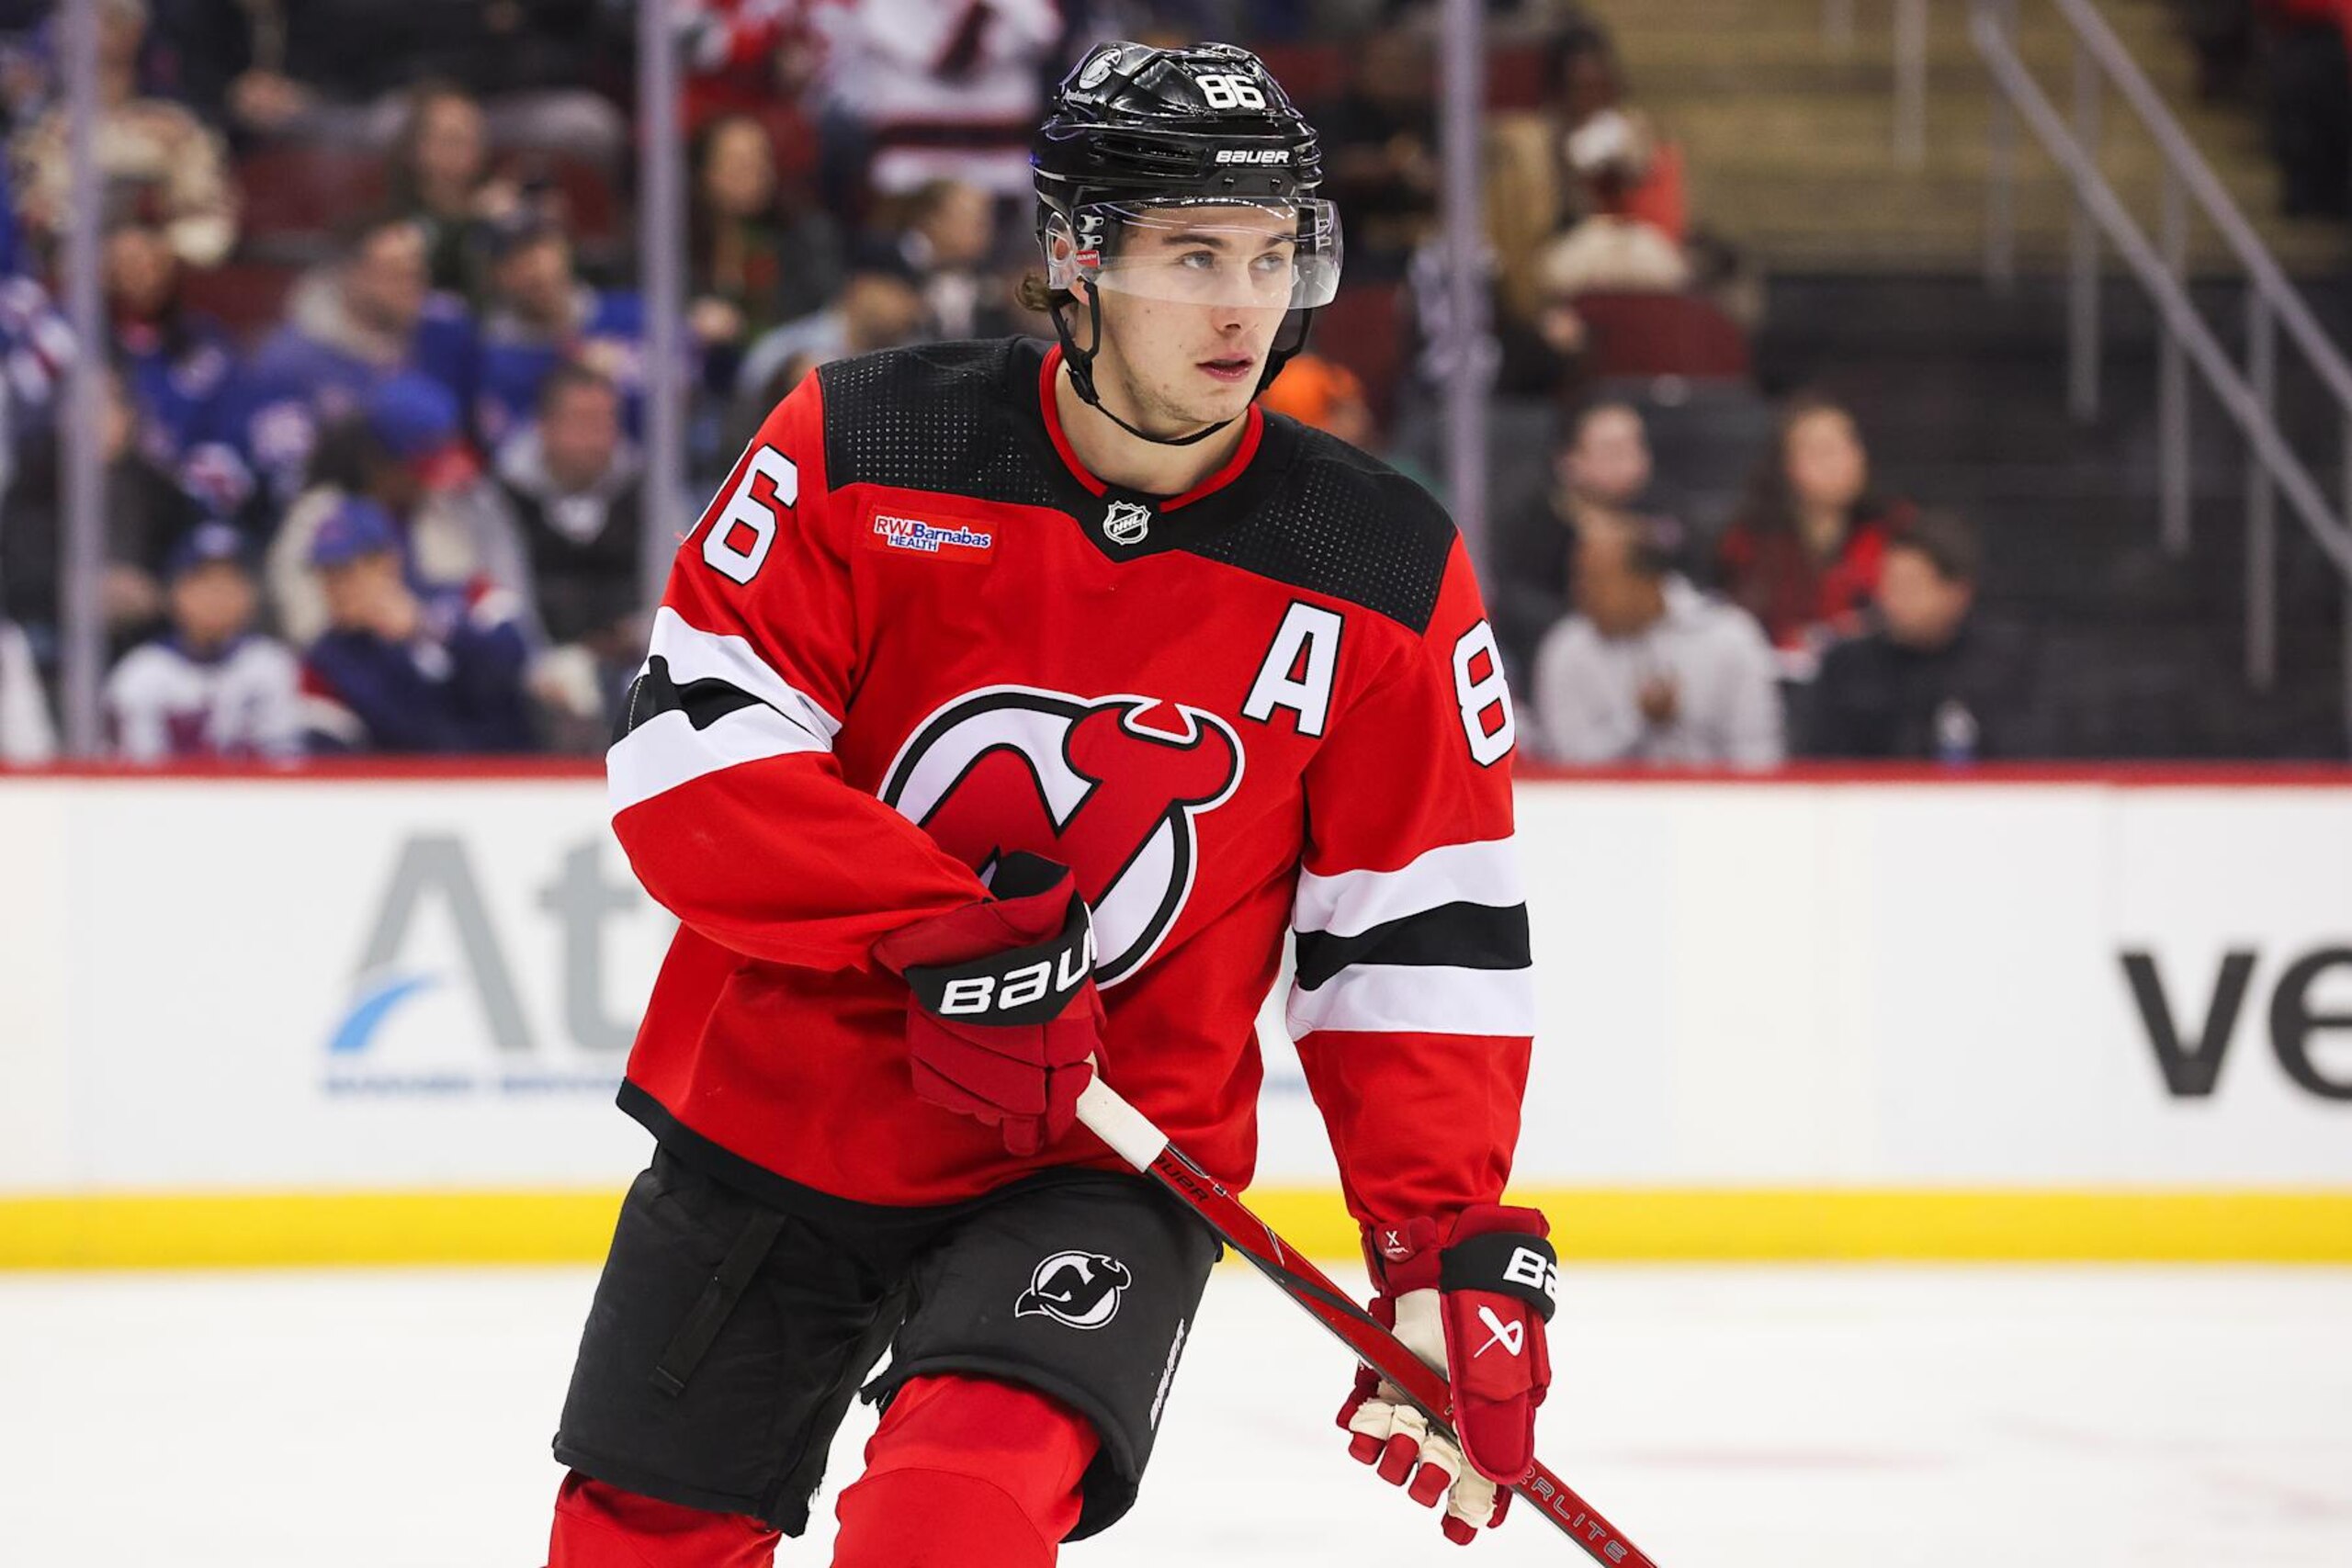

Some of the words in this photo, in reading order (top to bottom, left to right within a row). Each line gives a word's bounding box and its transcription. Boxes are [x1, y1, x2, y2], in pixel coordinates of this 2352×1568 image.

[1195, 74, 1266, 108] 86
[1216, 150, 1289, 164] BAUER
[875, 516, 990, 547] RWJBarnabas
[1113, 514, 1142, 533] NHL
[888, 535, 938, 552] HEALTH
[1241, 599, 1344, 739] A
[939, 901, 1098, 1015] BAU
